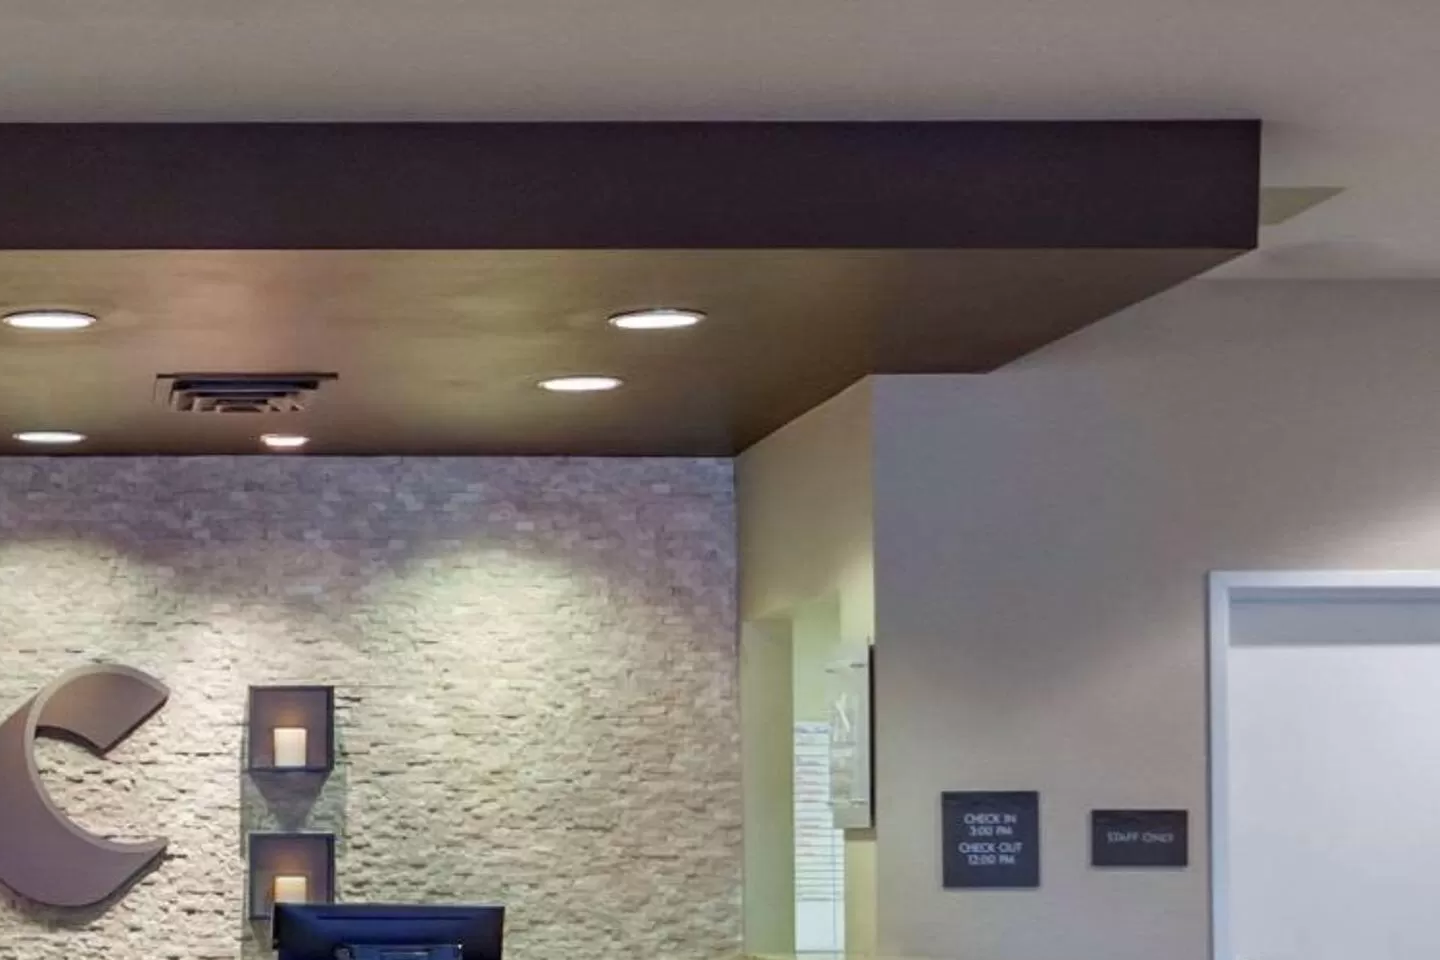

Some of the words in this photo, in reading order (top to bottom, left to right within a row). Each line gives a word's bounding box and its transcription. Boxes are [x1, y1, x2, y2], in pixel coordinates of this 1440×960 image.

[963, 813, 1001, 825] CHECK
[1003, 813, 1018, 825] IN
[995, 825, 1014, 836] PM
[1107, 831, 1139, 844] STAFF
[958, 842, 997, 854] CHECK
[999, 842, 1024, 854] OUT
[967, 854, 997, 866] 12:00
[999, 854, 1016, 866] PM
